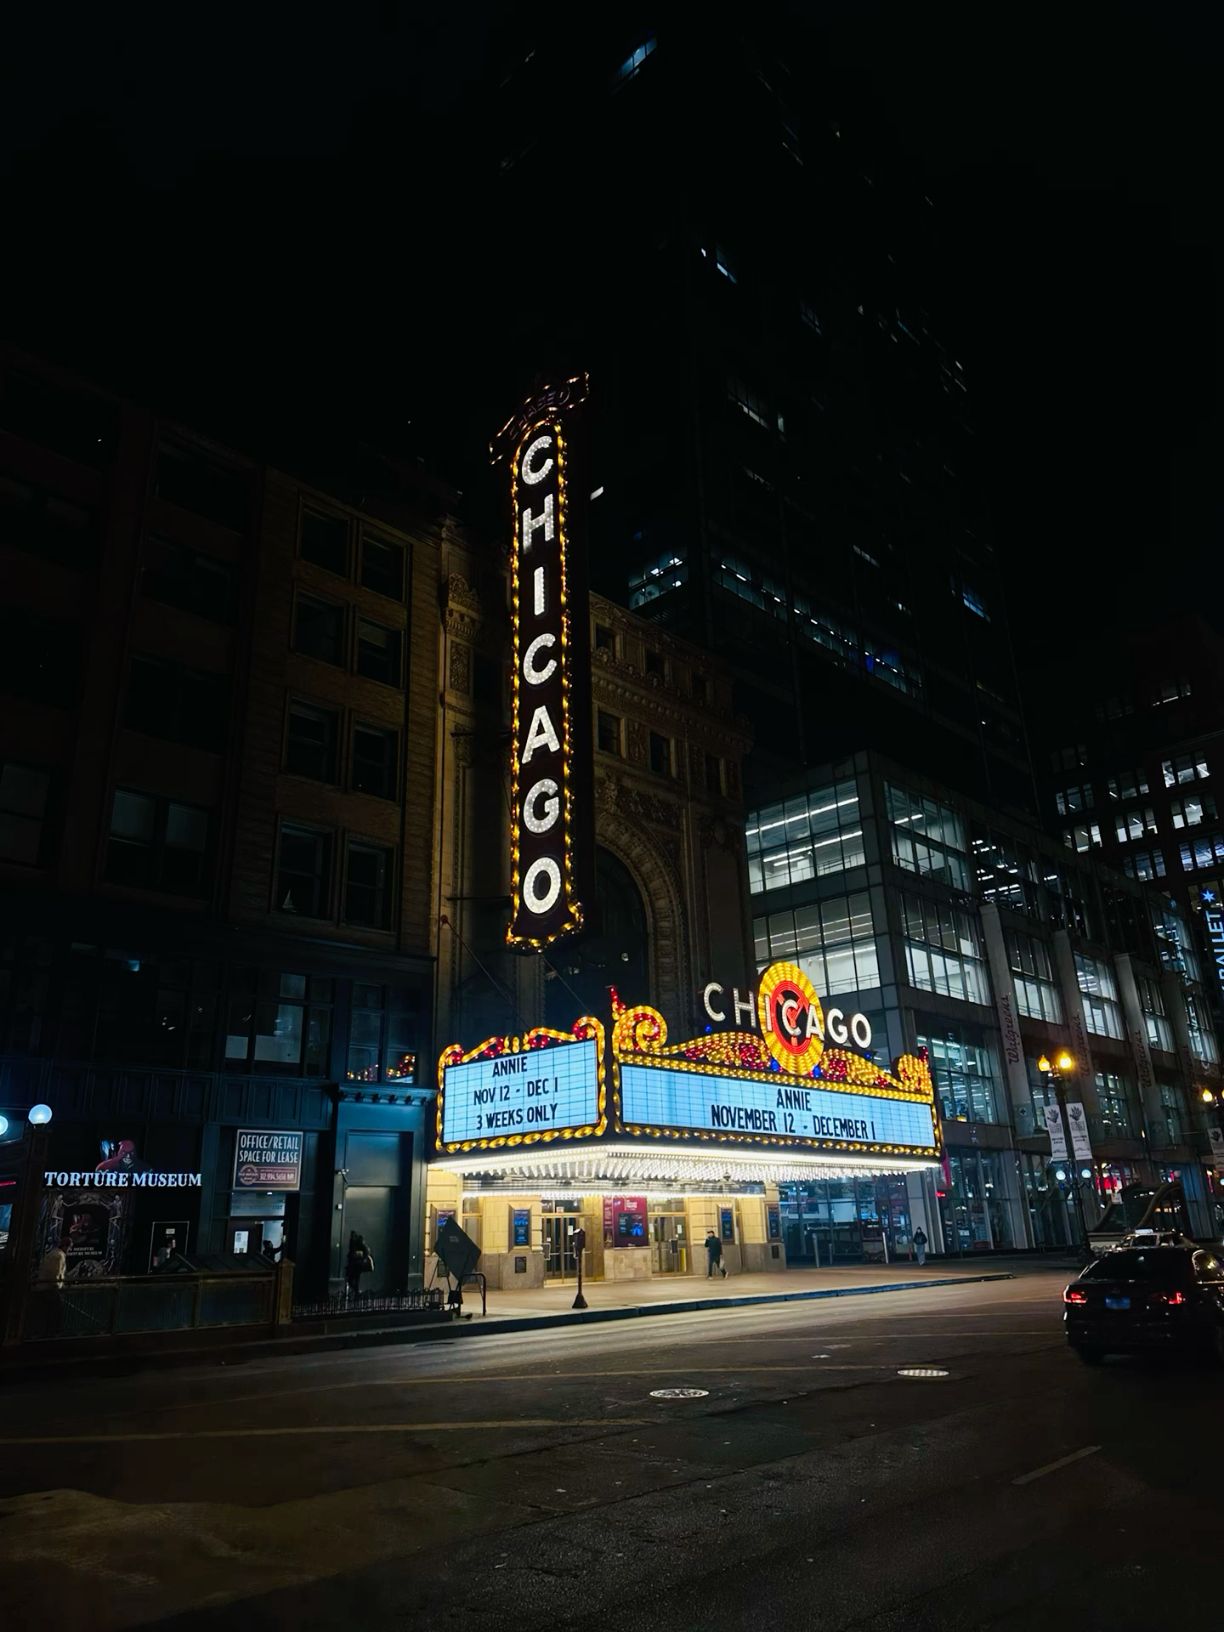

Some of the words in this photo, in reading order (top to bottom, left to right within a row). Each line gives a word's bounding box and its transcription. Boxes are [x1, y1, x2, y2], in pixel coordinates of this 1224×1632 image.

[521, 435, 562, 914] CHICAGO
[704, 982, 872, 1048] CHICAGO
[492, 1056, 528, 1078] ANNIE
[473, 1087, 496, 1106] NOV
[499, 1084, 511, 1102] 12
[527, 1078, 549, 1097] DEC
[554, 1077, 559, 1093] 1
[776, 1088, 812, 1112] ANNIE
[476, 1116, 483, 1130] 3
[486, 1108, 523, 1129] WEEKS
[527, 1103, 558, 1123] ONLY
[711, 1104, 776, 1132] NOVEMBER
[783, 1113, 795, 1133] 12
[813, 1115, 867, 1140] DECEMBER
[871, 1121, 876, 1140] 1
[240, 1134, 299, 1149] OFFICE/RETAIL
[239, 1150, 261, 1162] SPACE
[262, 1151, 276, 1162] FOR
[278, 1151, 298, 1163] LEASE
[44, 1170, 129, 1187] TORTURE
[131, 1172, 202, 1187] MUSEUM
